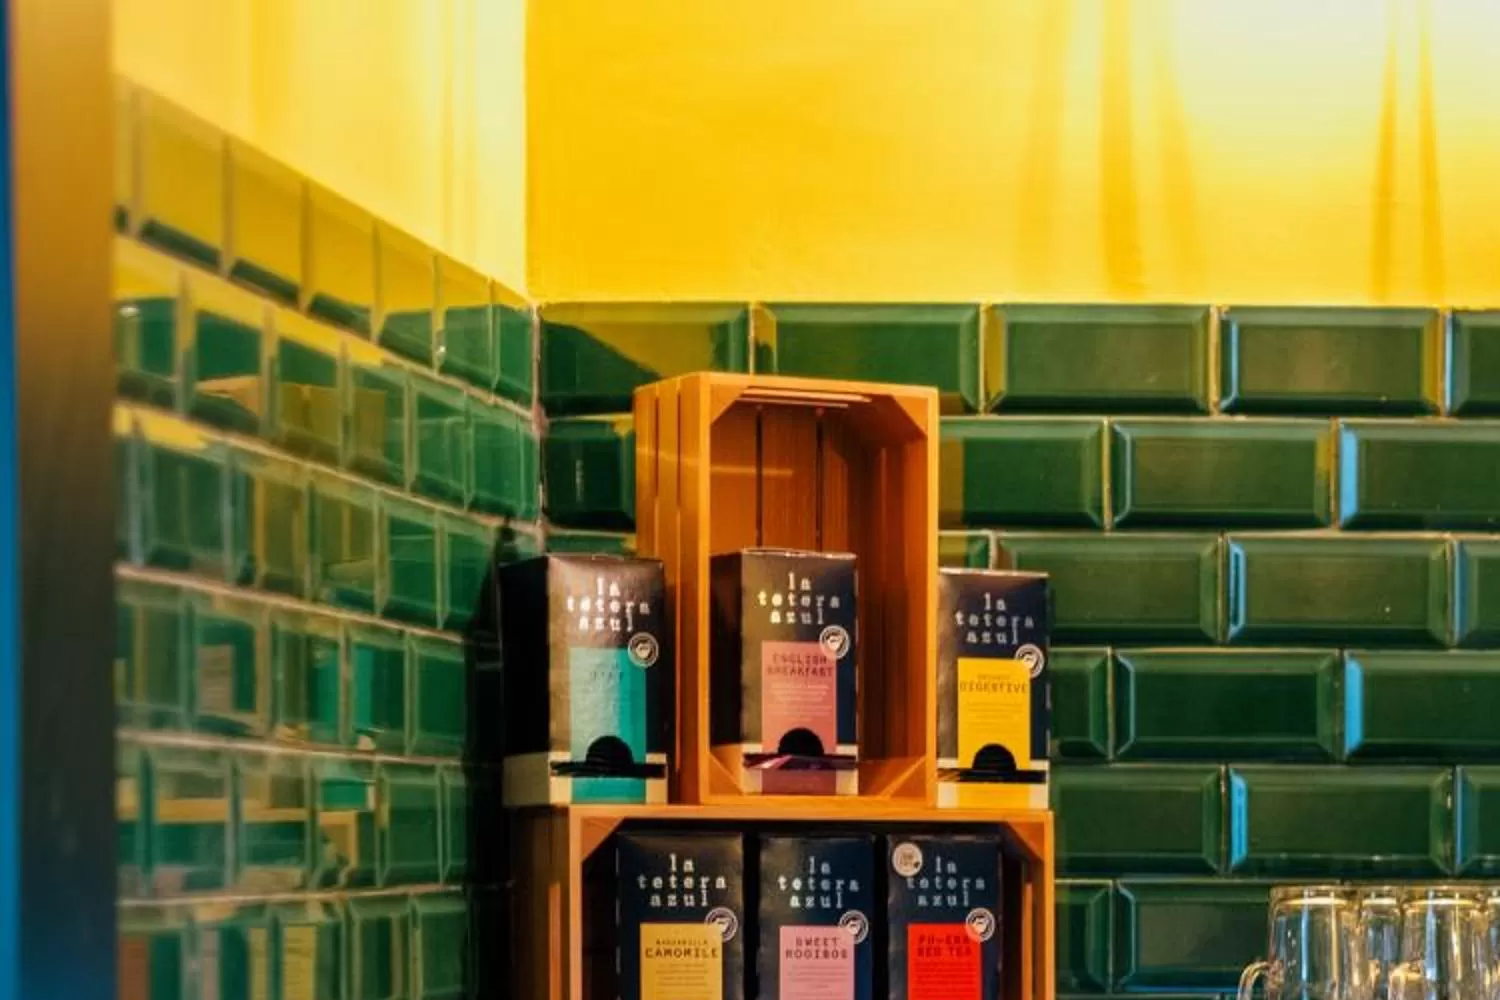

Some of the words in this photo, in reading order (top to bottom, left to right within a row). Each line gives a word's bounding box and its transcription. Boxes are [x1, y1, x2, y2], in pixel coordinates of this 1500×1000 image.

[597, 577, 620, 596] la
[788, 571, 811, 591] la
[567, 596, 650, 615] tetera
[758, 590, 840, 609] tetera
[984, 592, 1006, 611] la
[955, 610, 1035, 629] tetera
[669, 853, 694, 873] la
[809, 856, 831, 875] la
[935, 855, 957, 874] la
[638, 874, 726, 889] tetera
[777, 875, 859, 892] tetera
[906, 874, 986, 891] tetera
[645, 947, 719, 959] CAMOMILE
[785, 949, 848, 959] ROOIBOS
